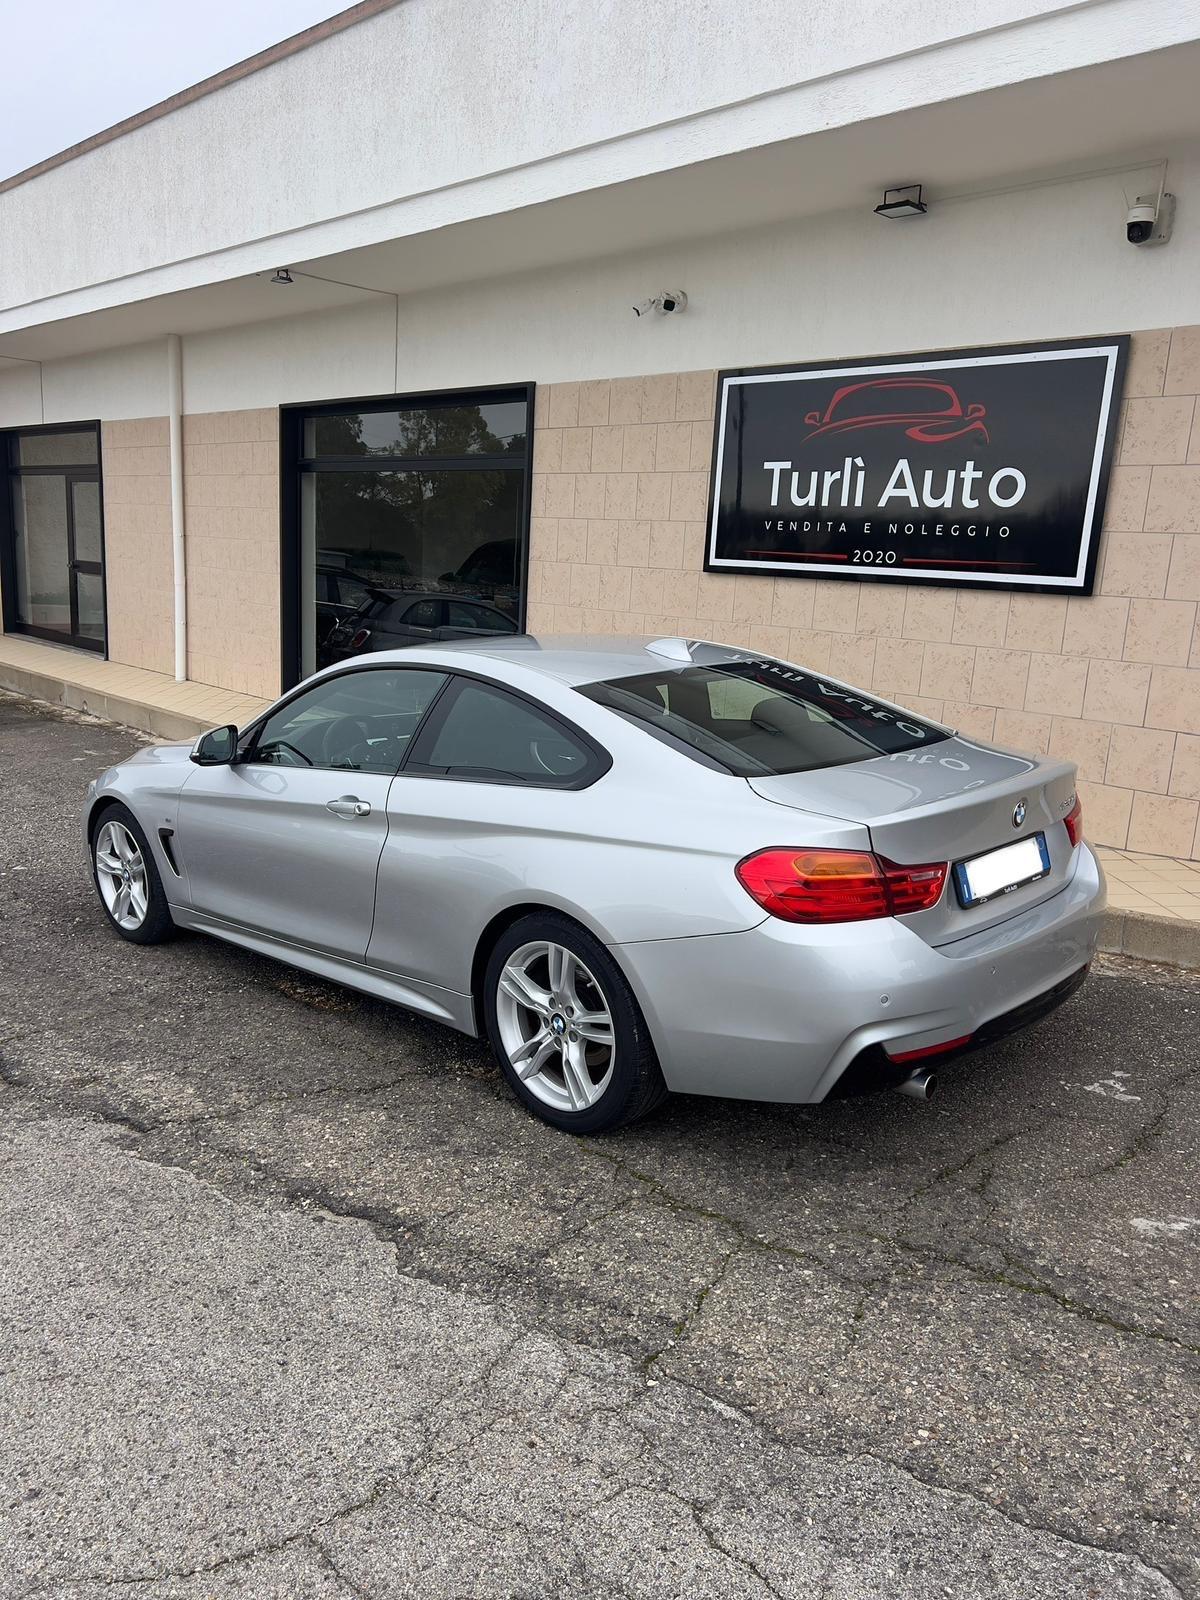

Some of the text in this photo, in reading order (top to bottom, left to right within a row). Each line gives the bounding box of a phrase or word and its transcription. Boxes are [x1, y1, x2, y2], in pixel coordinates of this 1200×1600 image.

[764, 456, 1027, 509] Turlì Auto
[764, 520, 1010, 538] VENDITA E NOLEGGIO
[852, 549, 897, 564] 2020
